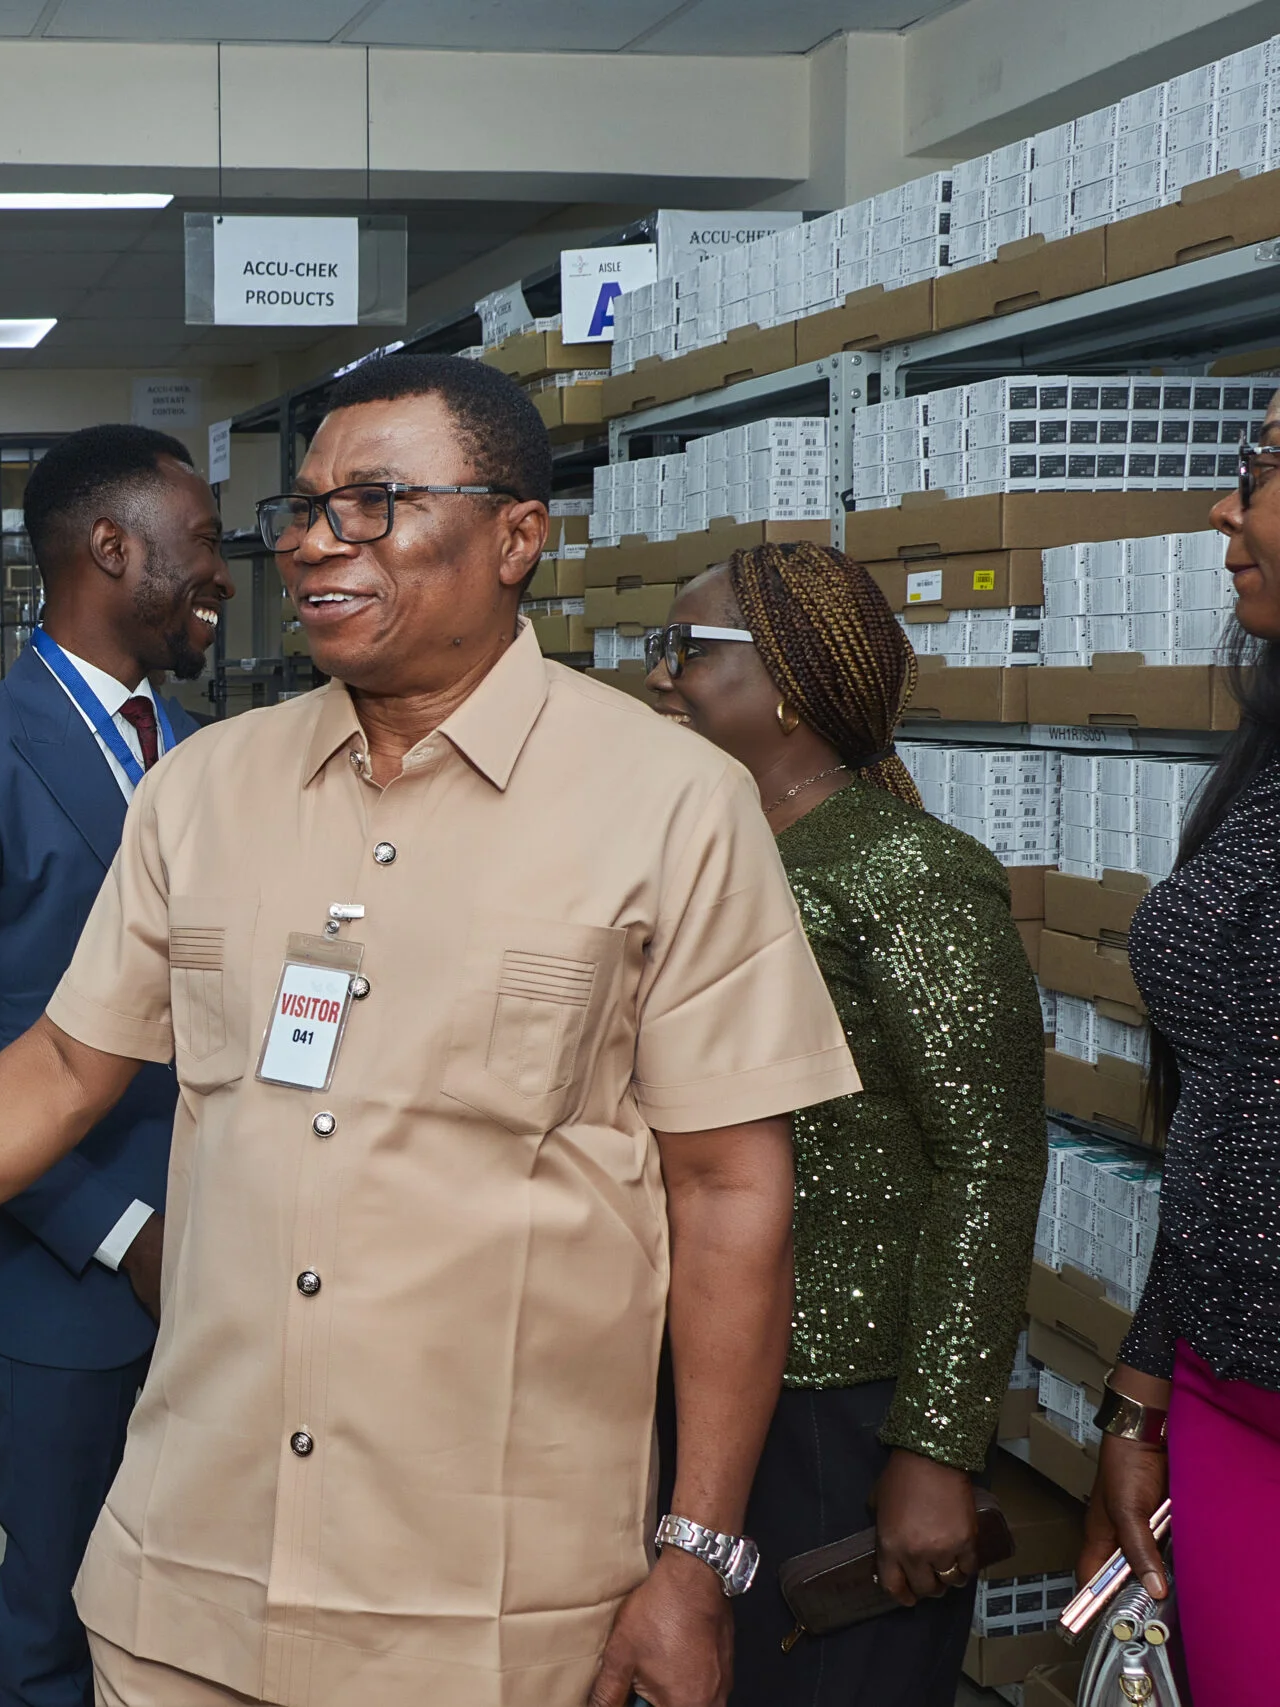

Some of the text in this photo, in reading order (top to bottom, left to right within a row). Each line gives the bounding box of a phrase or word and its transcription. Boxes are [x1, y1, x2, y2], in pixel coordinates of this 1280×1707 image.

[243, 261, 338, 278] ACCU-CHEK
[598, 262, 621, 273] AISLE
[245, 290, 335, 307] PRODUCTS
[587, 282, 623, 337] A
[281, 992, 341, 1024] VISITOR
[292, 1028, 314, 1045] 041
